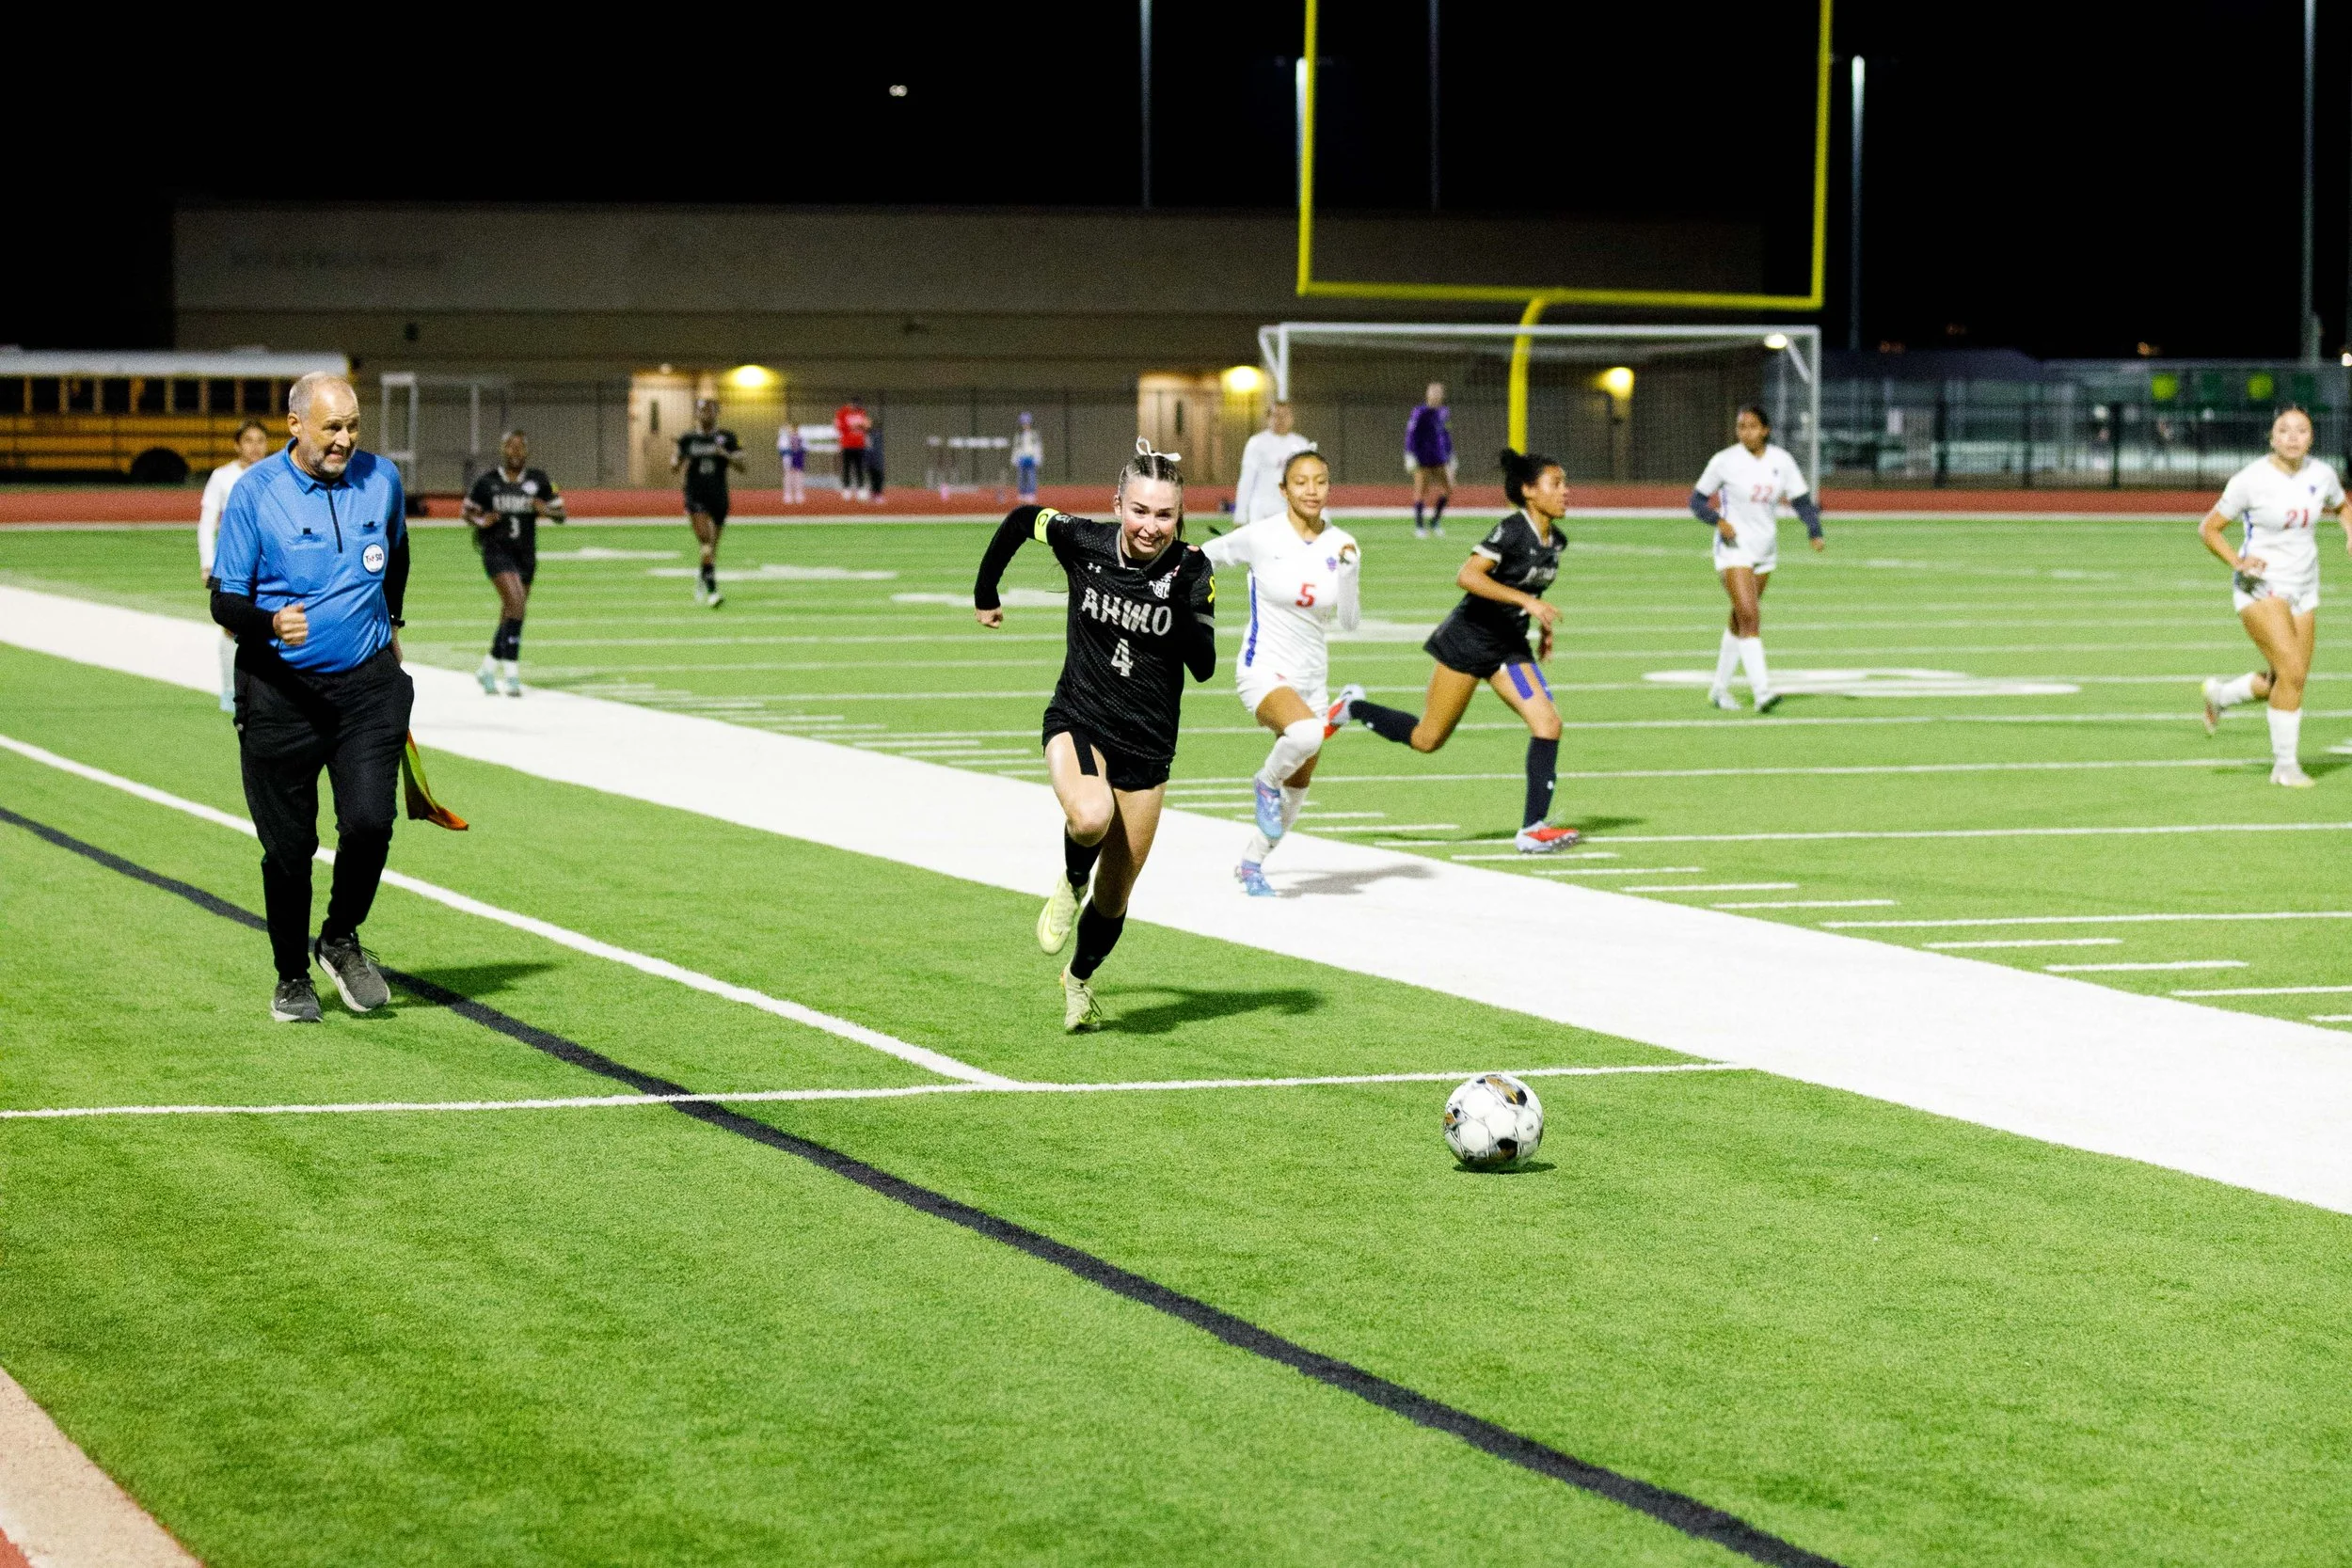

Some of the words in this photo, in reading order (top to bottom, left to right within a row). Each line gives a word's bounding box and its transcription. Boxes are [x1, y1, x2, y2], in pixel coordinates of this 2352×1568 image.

[1751, 484, 1773, 503] 22
[2282, 509, 2310, 530] 21
[1295, 583, 1316, 608] 5
[1110, 638, 1134, 677] 4
